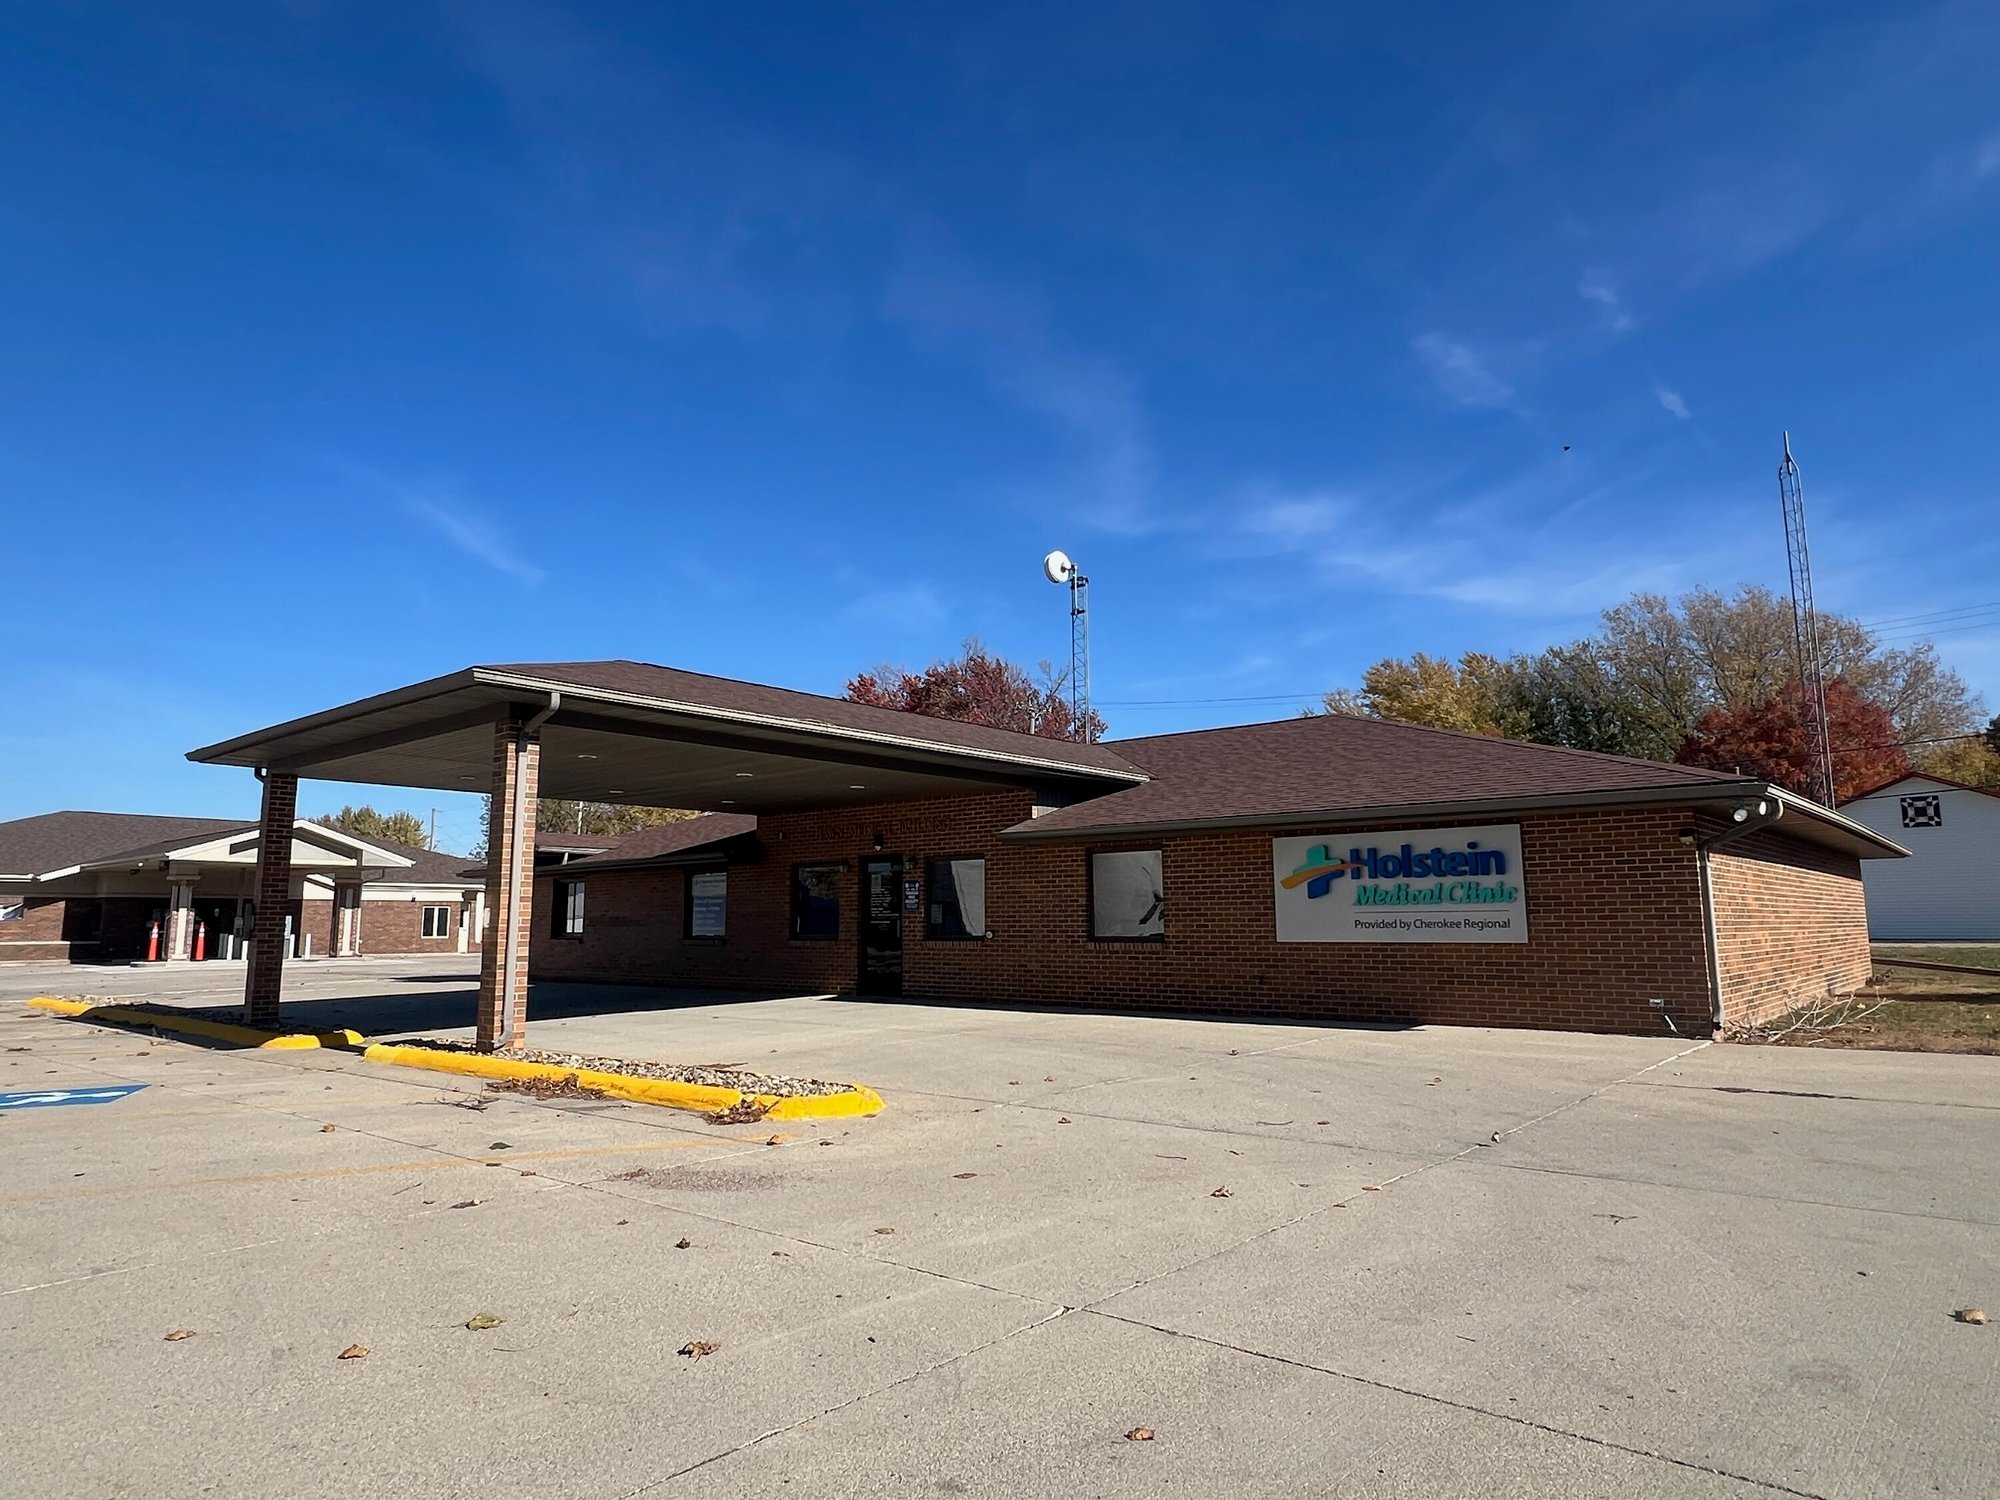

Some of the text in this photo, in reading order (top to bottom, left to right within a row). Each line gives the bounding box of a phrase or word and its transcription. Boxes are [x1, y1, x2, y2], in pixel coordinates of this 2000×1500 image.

[1349, 841, 1506, 880] Holstein
[1352, 880, 1518, 907] Medical Clinic
[1354, 917, 1511, 931] Provided by Cherokee Regional
